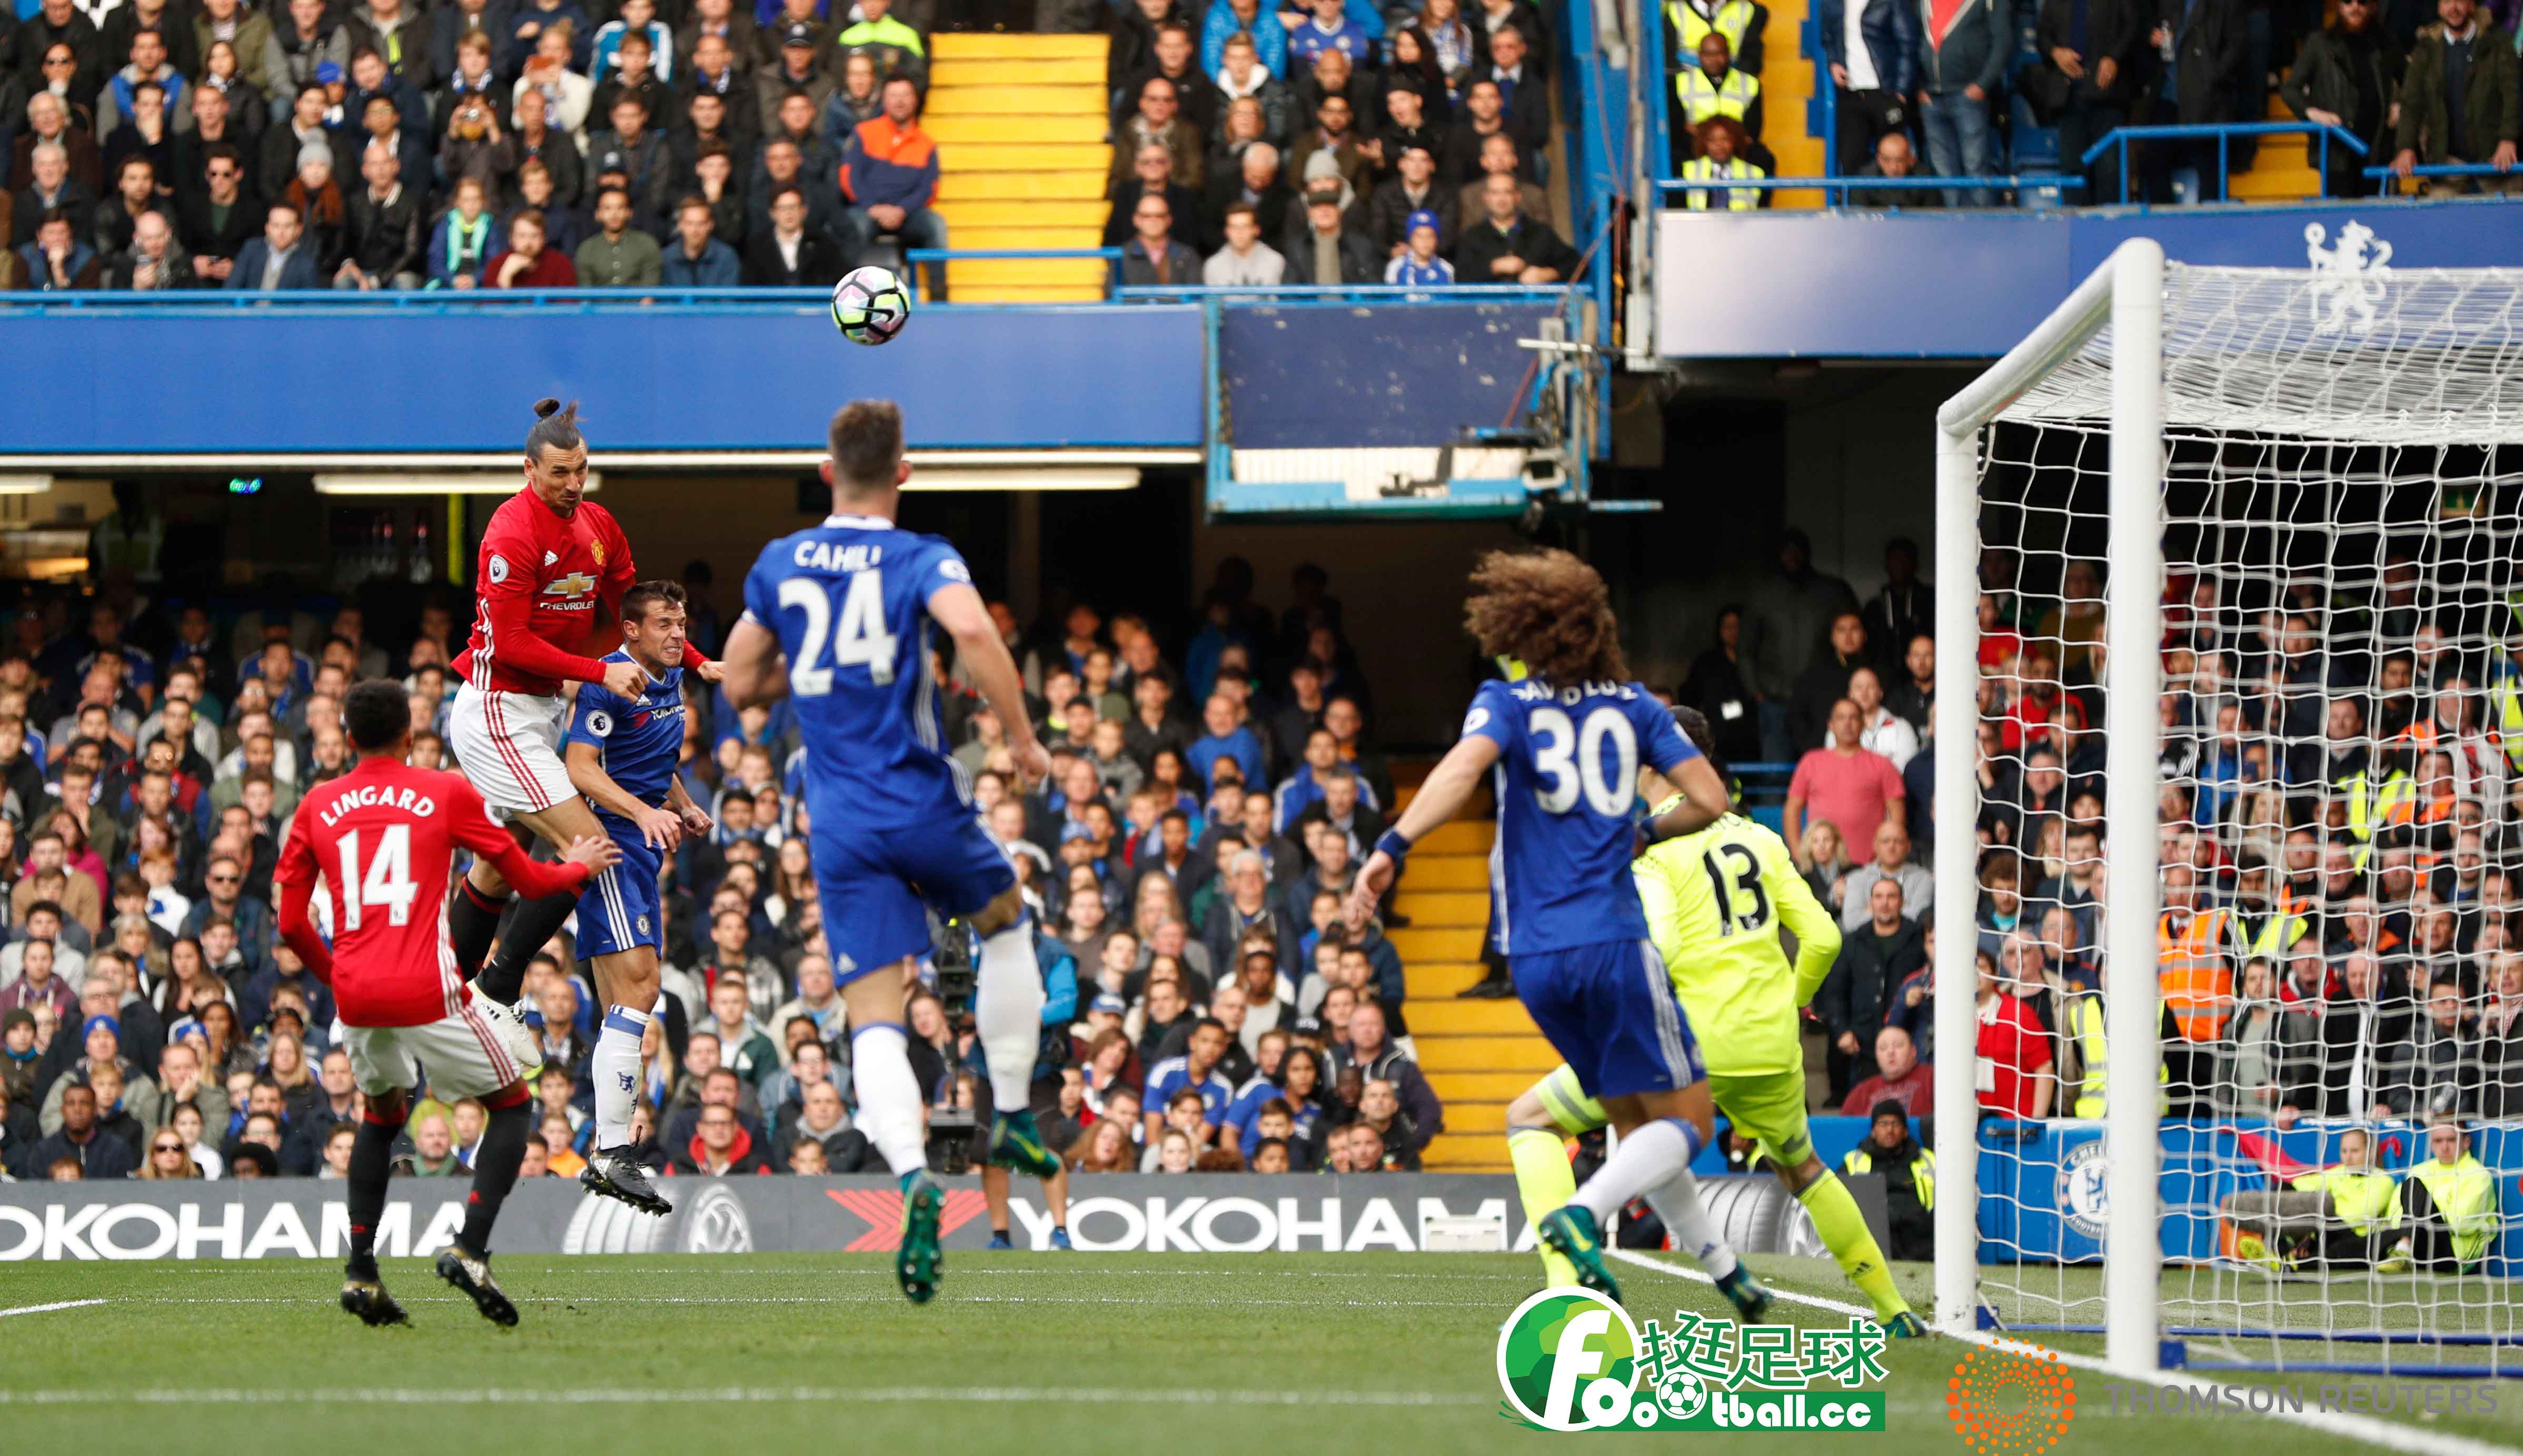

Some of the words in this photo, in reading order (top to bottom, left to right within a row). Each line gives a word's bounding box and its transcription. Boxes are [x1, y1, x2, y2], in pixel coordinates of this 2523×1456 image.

[778, 569, 897, 696] 24
[320, 785, 436, 827] LINGARD
[1529, 706, 1638, 817] 30
[335, 823, 419, 932] 14
[1703, 843, 1769, 937] 13
[1007, 1196, 1541, 1251] YOKOHAM
